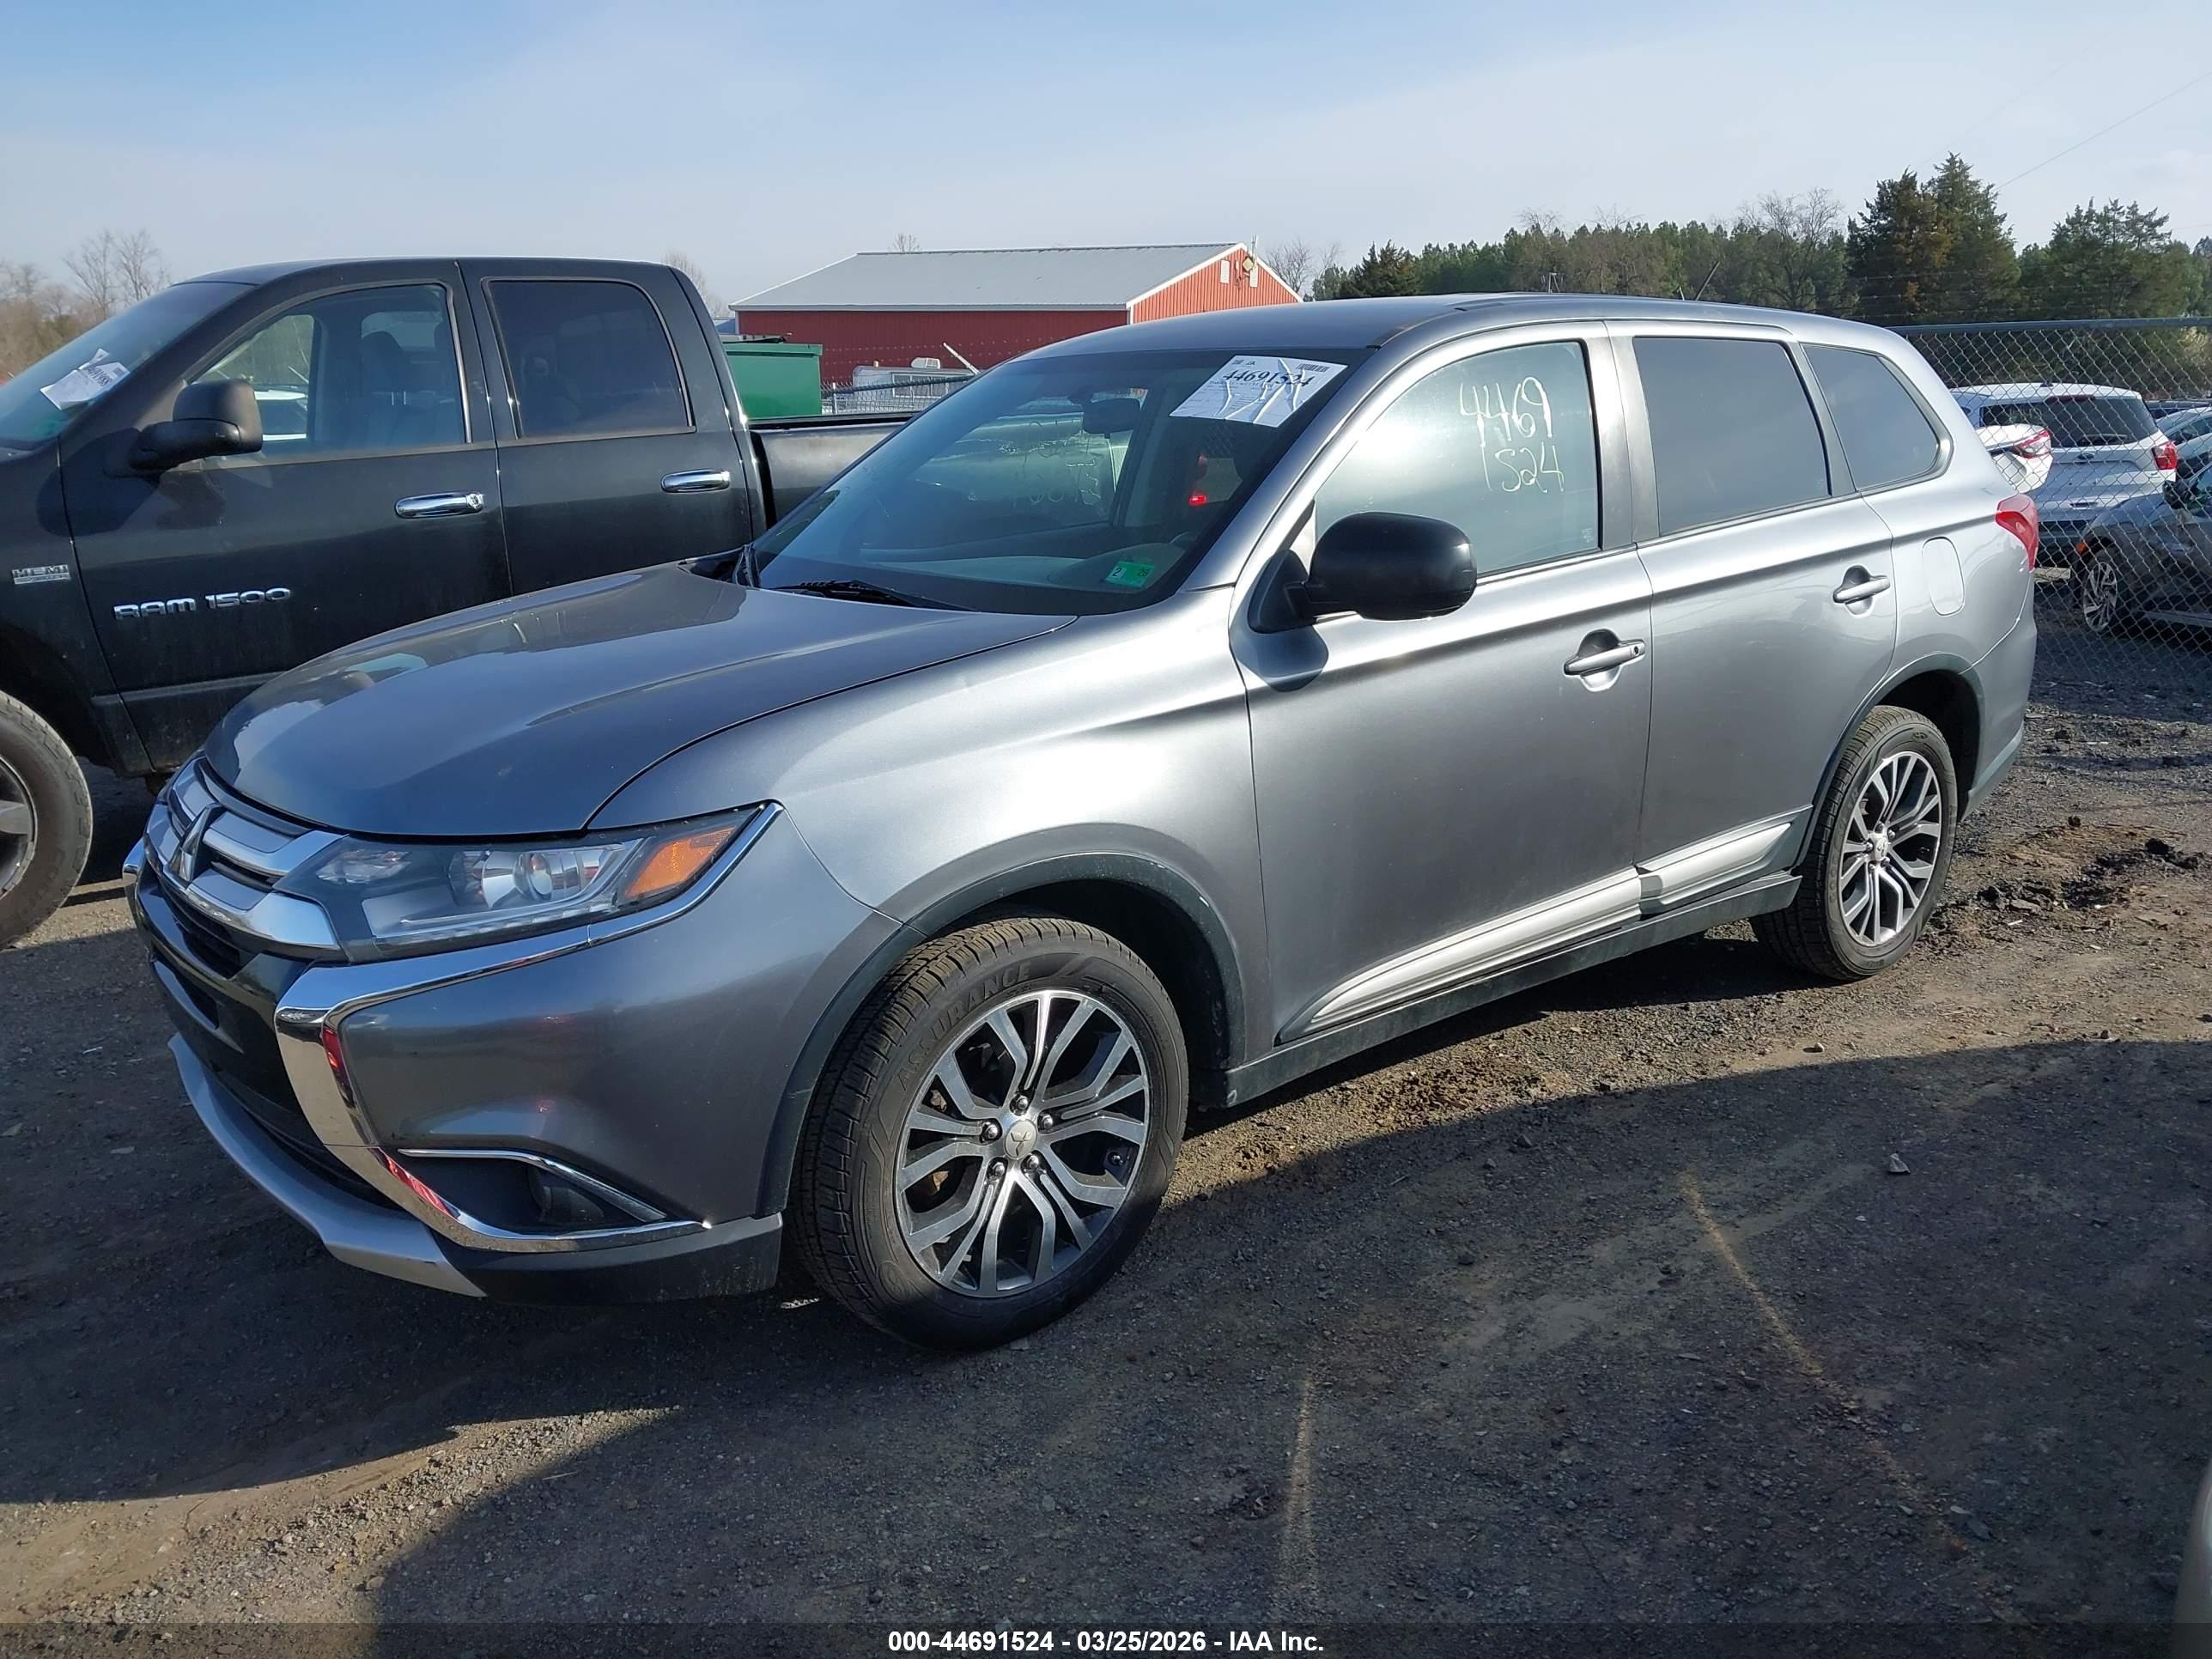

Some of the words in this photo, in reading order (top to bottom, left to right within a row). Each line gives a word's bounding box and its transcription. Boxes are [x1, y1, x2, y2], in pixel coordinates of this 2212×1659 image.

[1223, 369, 1316, 386] 44691524
[1460, 377, 1553, 446] 4469
[1481, 441, 1565, 492] 1524
[113, 598, 197, 620] RAM
[205, 587, 291, 610] 1500
[896, 963, 1030, 1091] ASSURANCE
